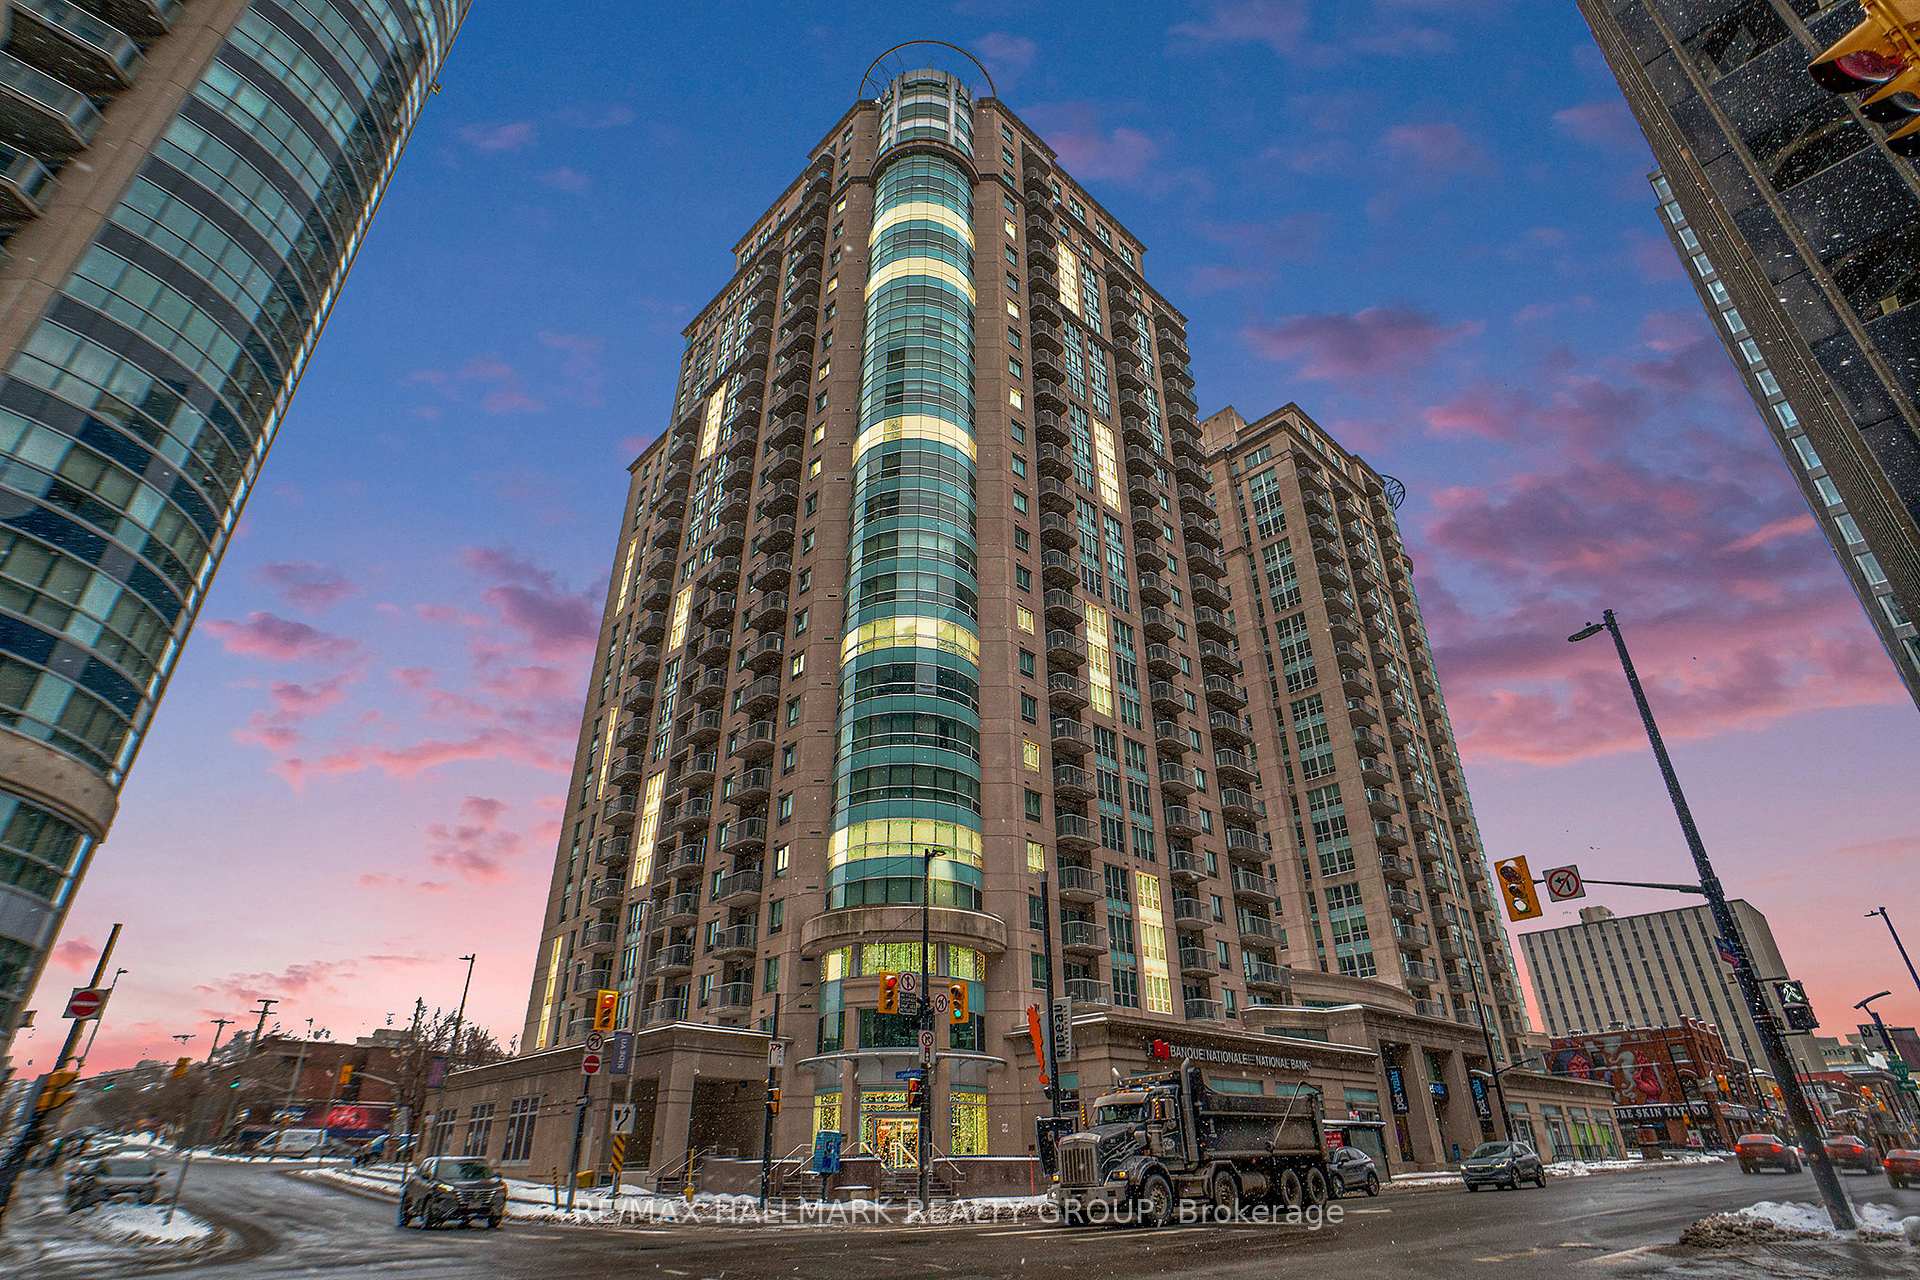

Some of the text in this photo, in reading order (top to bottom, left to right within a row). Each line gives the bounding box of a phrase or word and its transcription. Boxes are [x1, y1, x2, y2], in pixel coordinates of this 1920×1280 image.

[1170, 1045, 1311, 1071] BANQUE NATIONALE NATIONAL BANK
[888, 1093, 906, 1102] 234
[1635, 1107, 1662, 1118] SKIN
